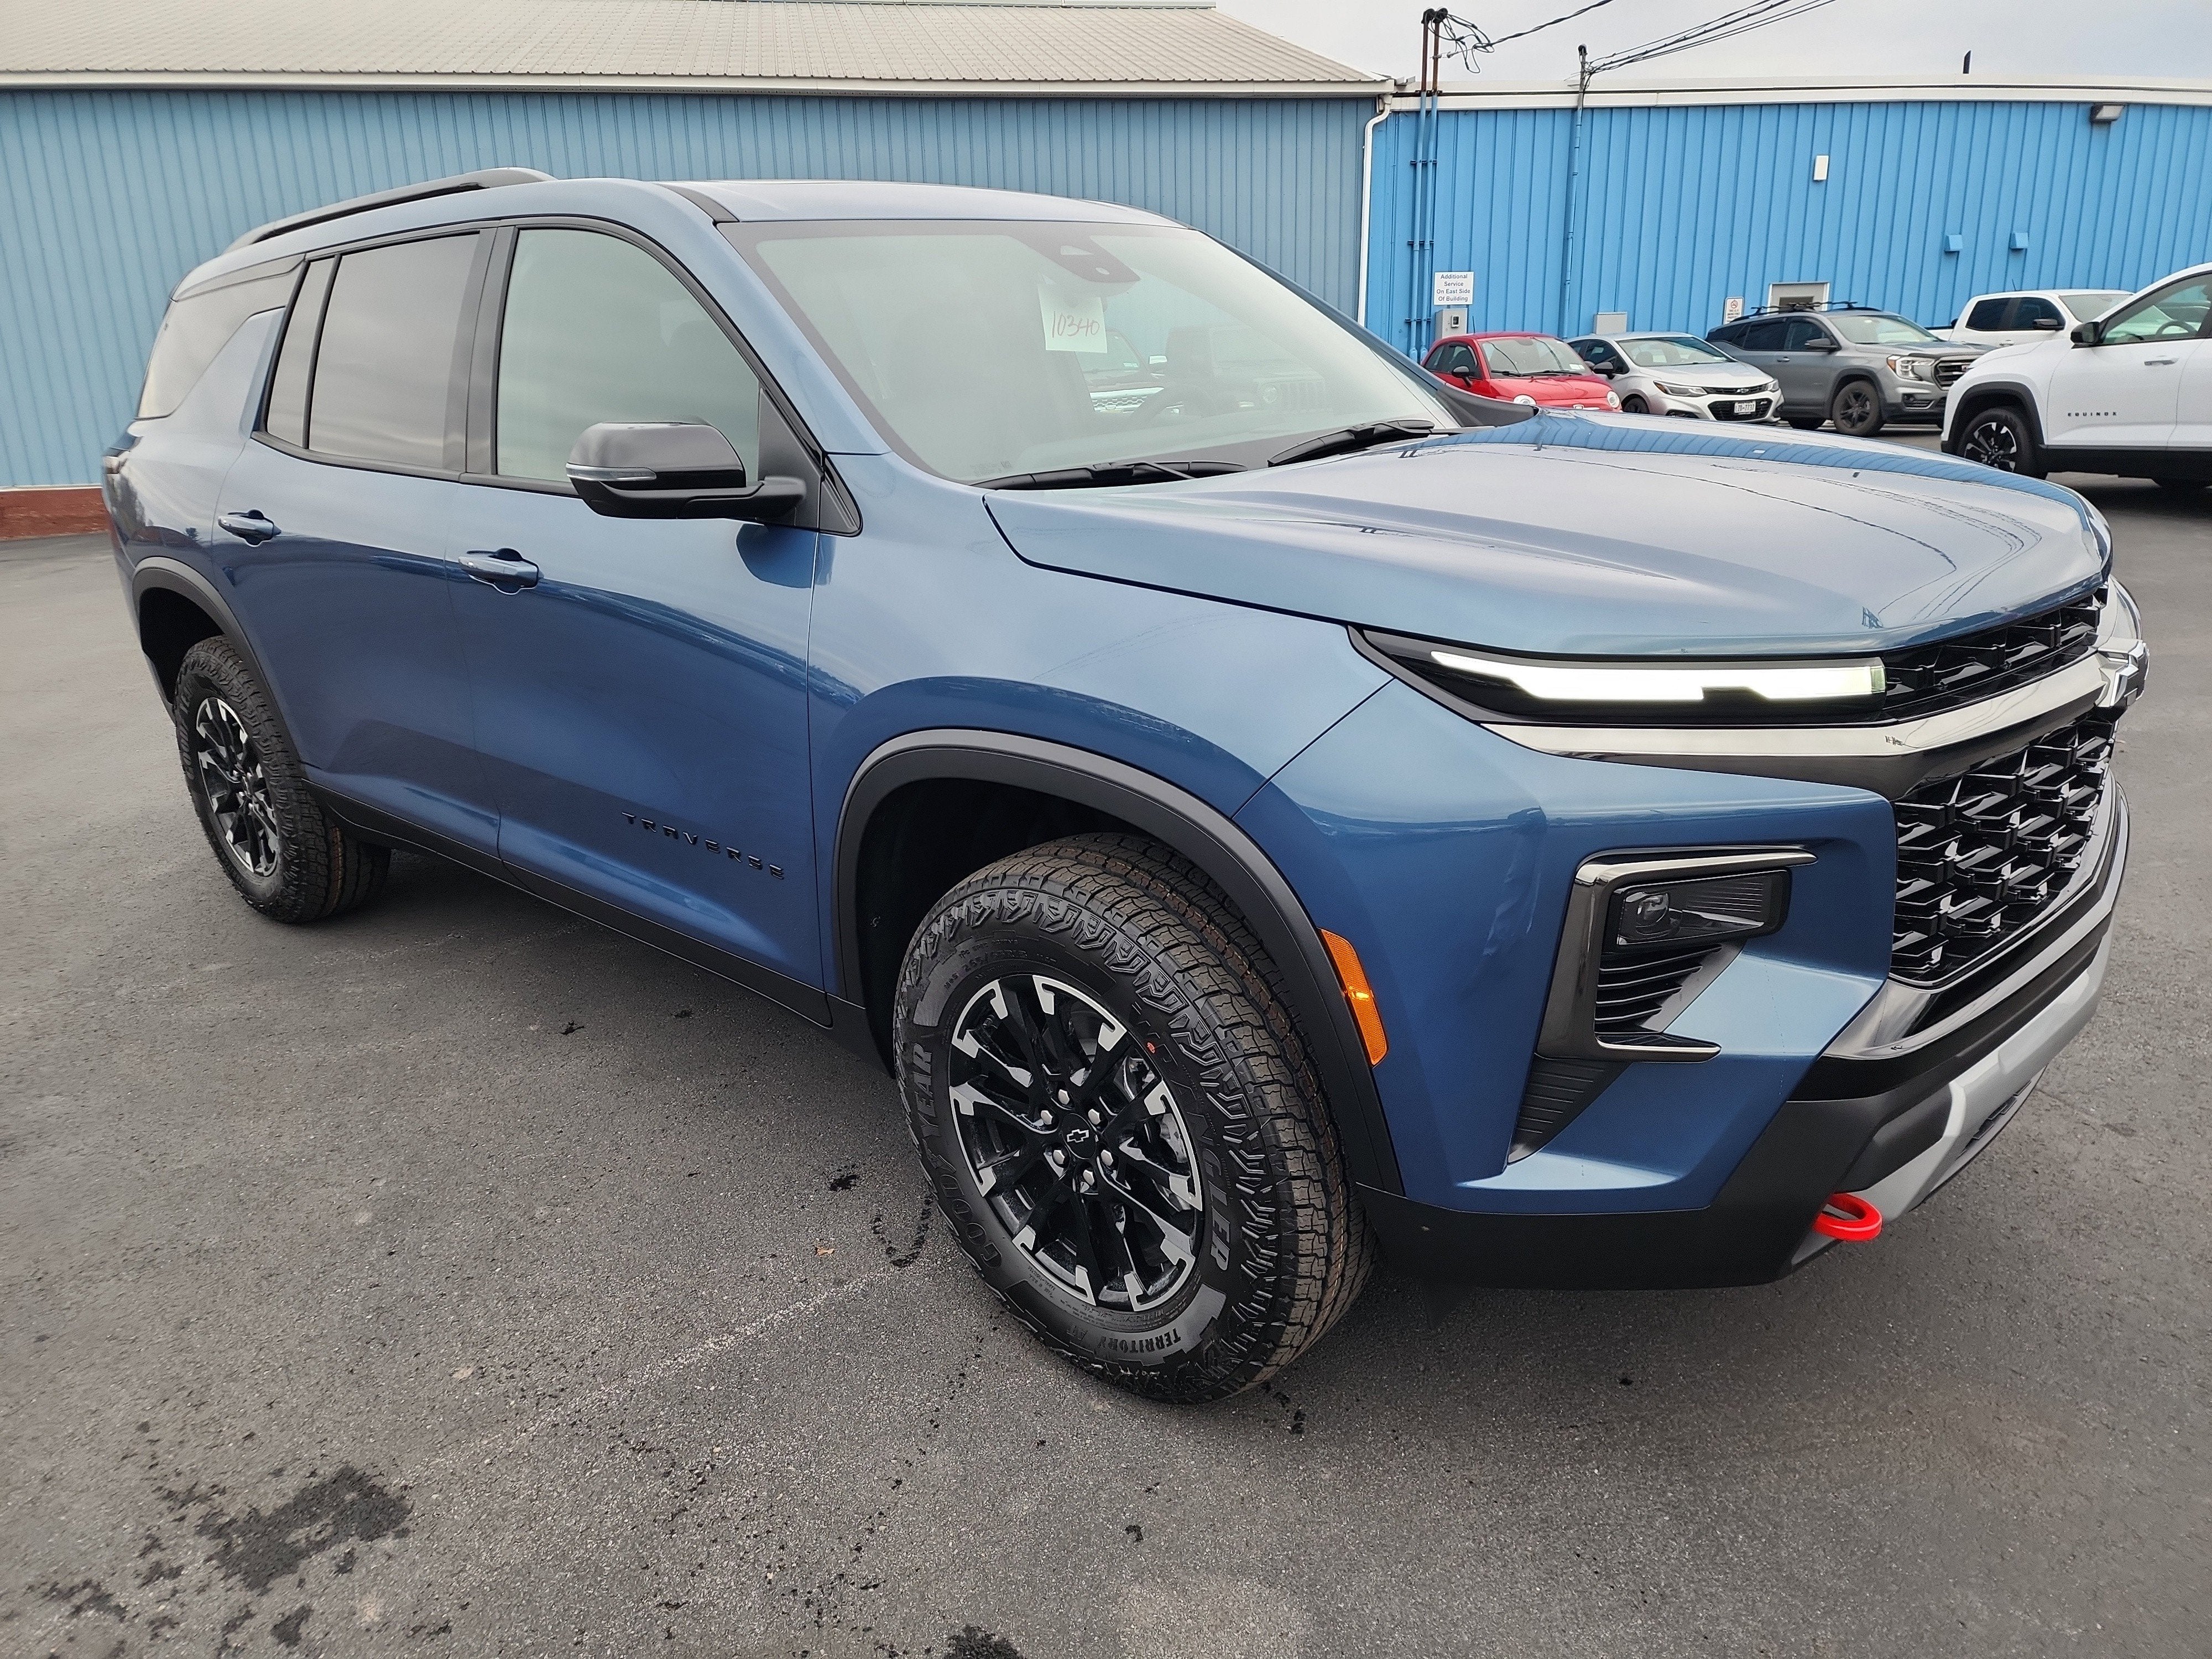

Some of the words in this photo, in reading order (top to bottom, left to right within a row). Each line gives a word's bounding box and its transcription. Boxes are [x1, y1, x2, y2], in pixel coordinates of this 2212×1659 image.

[1052, 311, 1100, 338] 10340
[621, 811, 785, 880] TRAVERSE
[1097, 1328, 1182, 1354] TERRITORY
